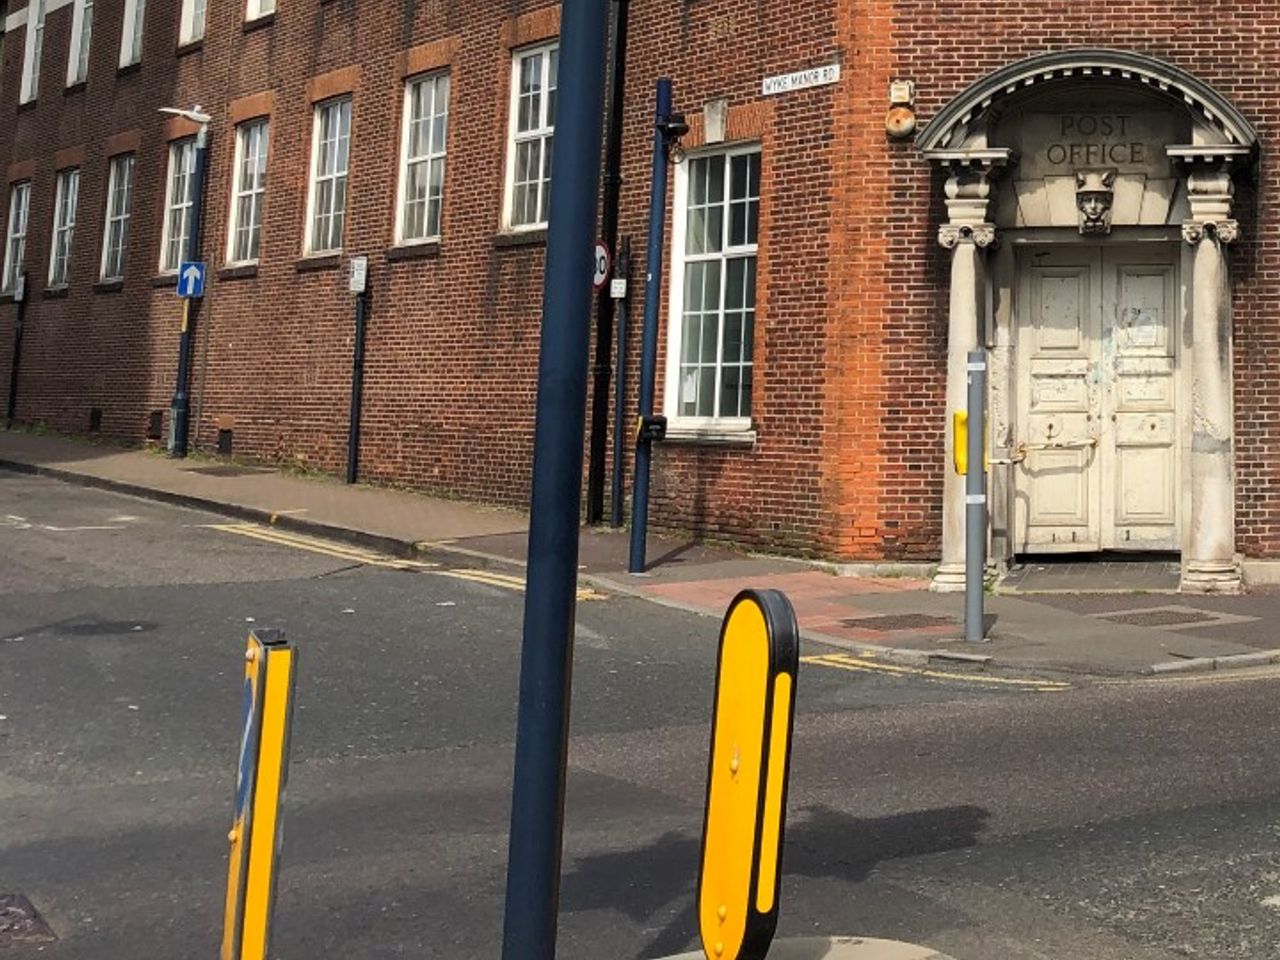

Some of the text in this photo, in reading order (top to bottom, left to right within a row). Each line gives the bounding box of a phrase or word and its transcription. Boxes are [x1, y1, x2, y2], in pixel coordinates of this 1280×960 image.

[791, 69, 820, 88] MANOR
[823, 67, 836, 81] RD
[1061, 115, 1132, 137] POST
[1047, 142, 1145, 165] OFFICE
